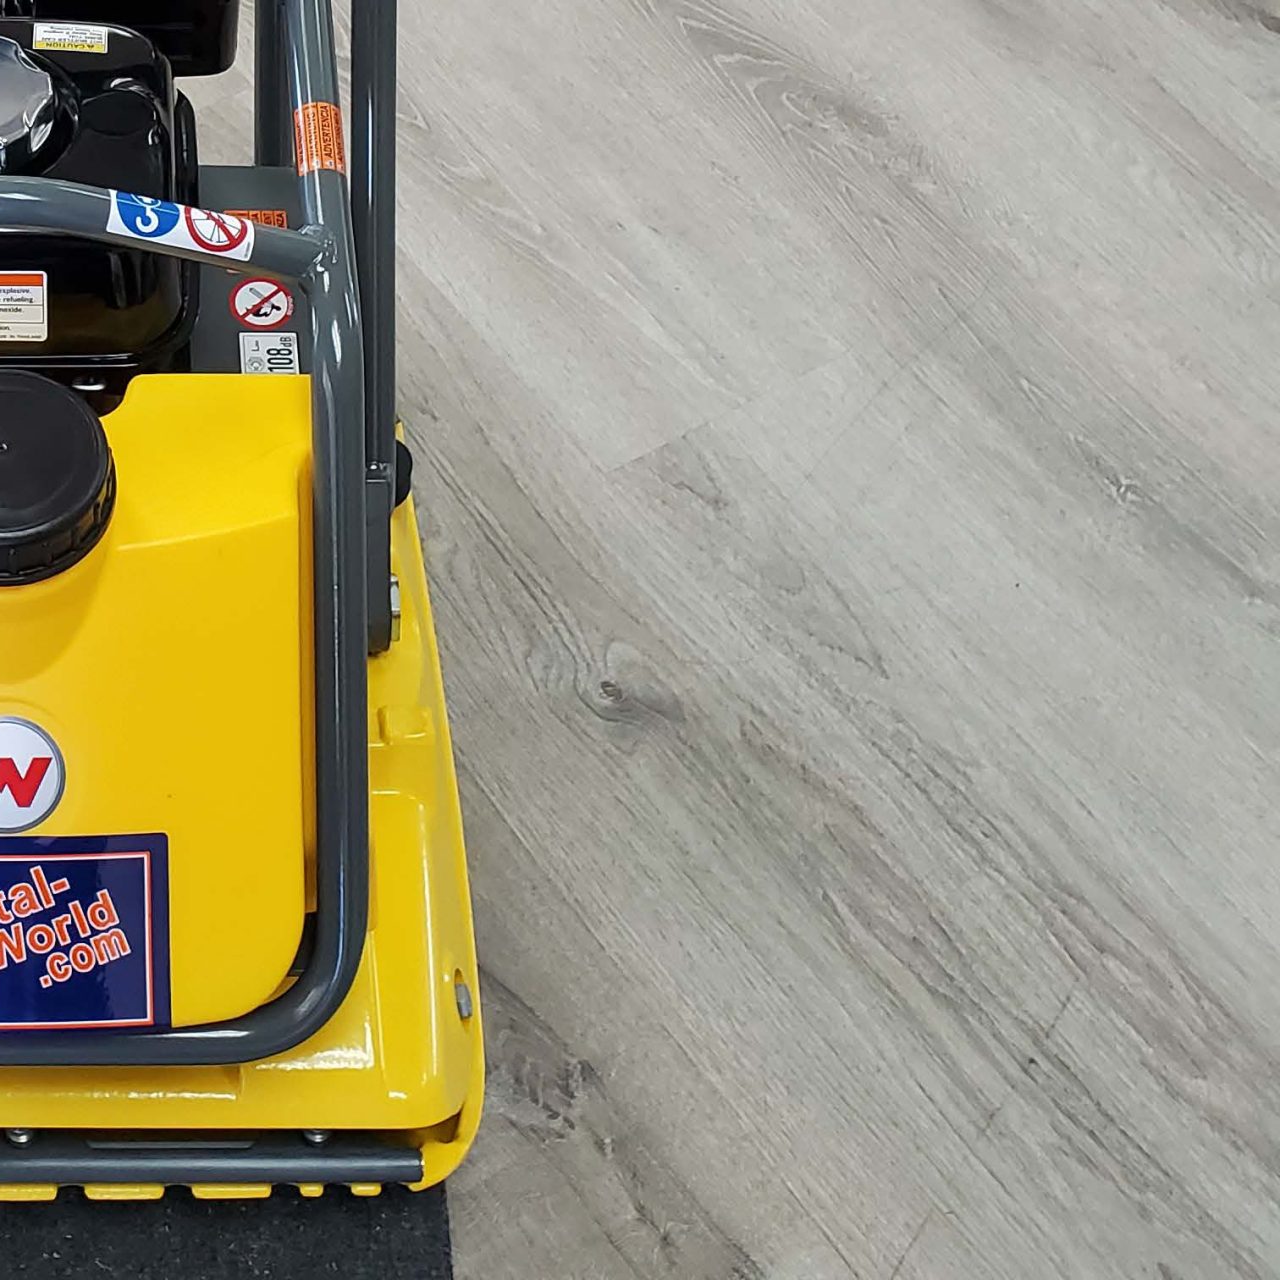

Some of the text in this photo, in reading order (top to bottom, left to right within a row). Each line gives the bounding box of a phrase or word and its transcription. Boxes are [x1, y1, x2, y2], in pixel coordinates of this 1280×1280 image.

[45, 41, 86, 49] CAUTION
[320, 105, 333, 159] ADVERTENCIA
[266, 348, 294, 372] 108
[39, 928, 131, 988] .com
